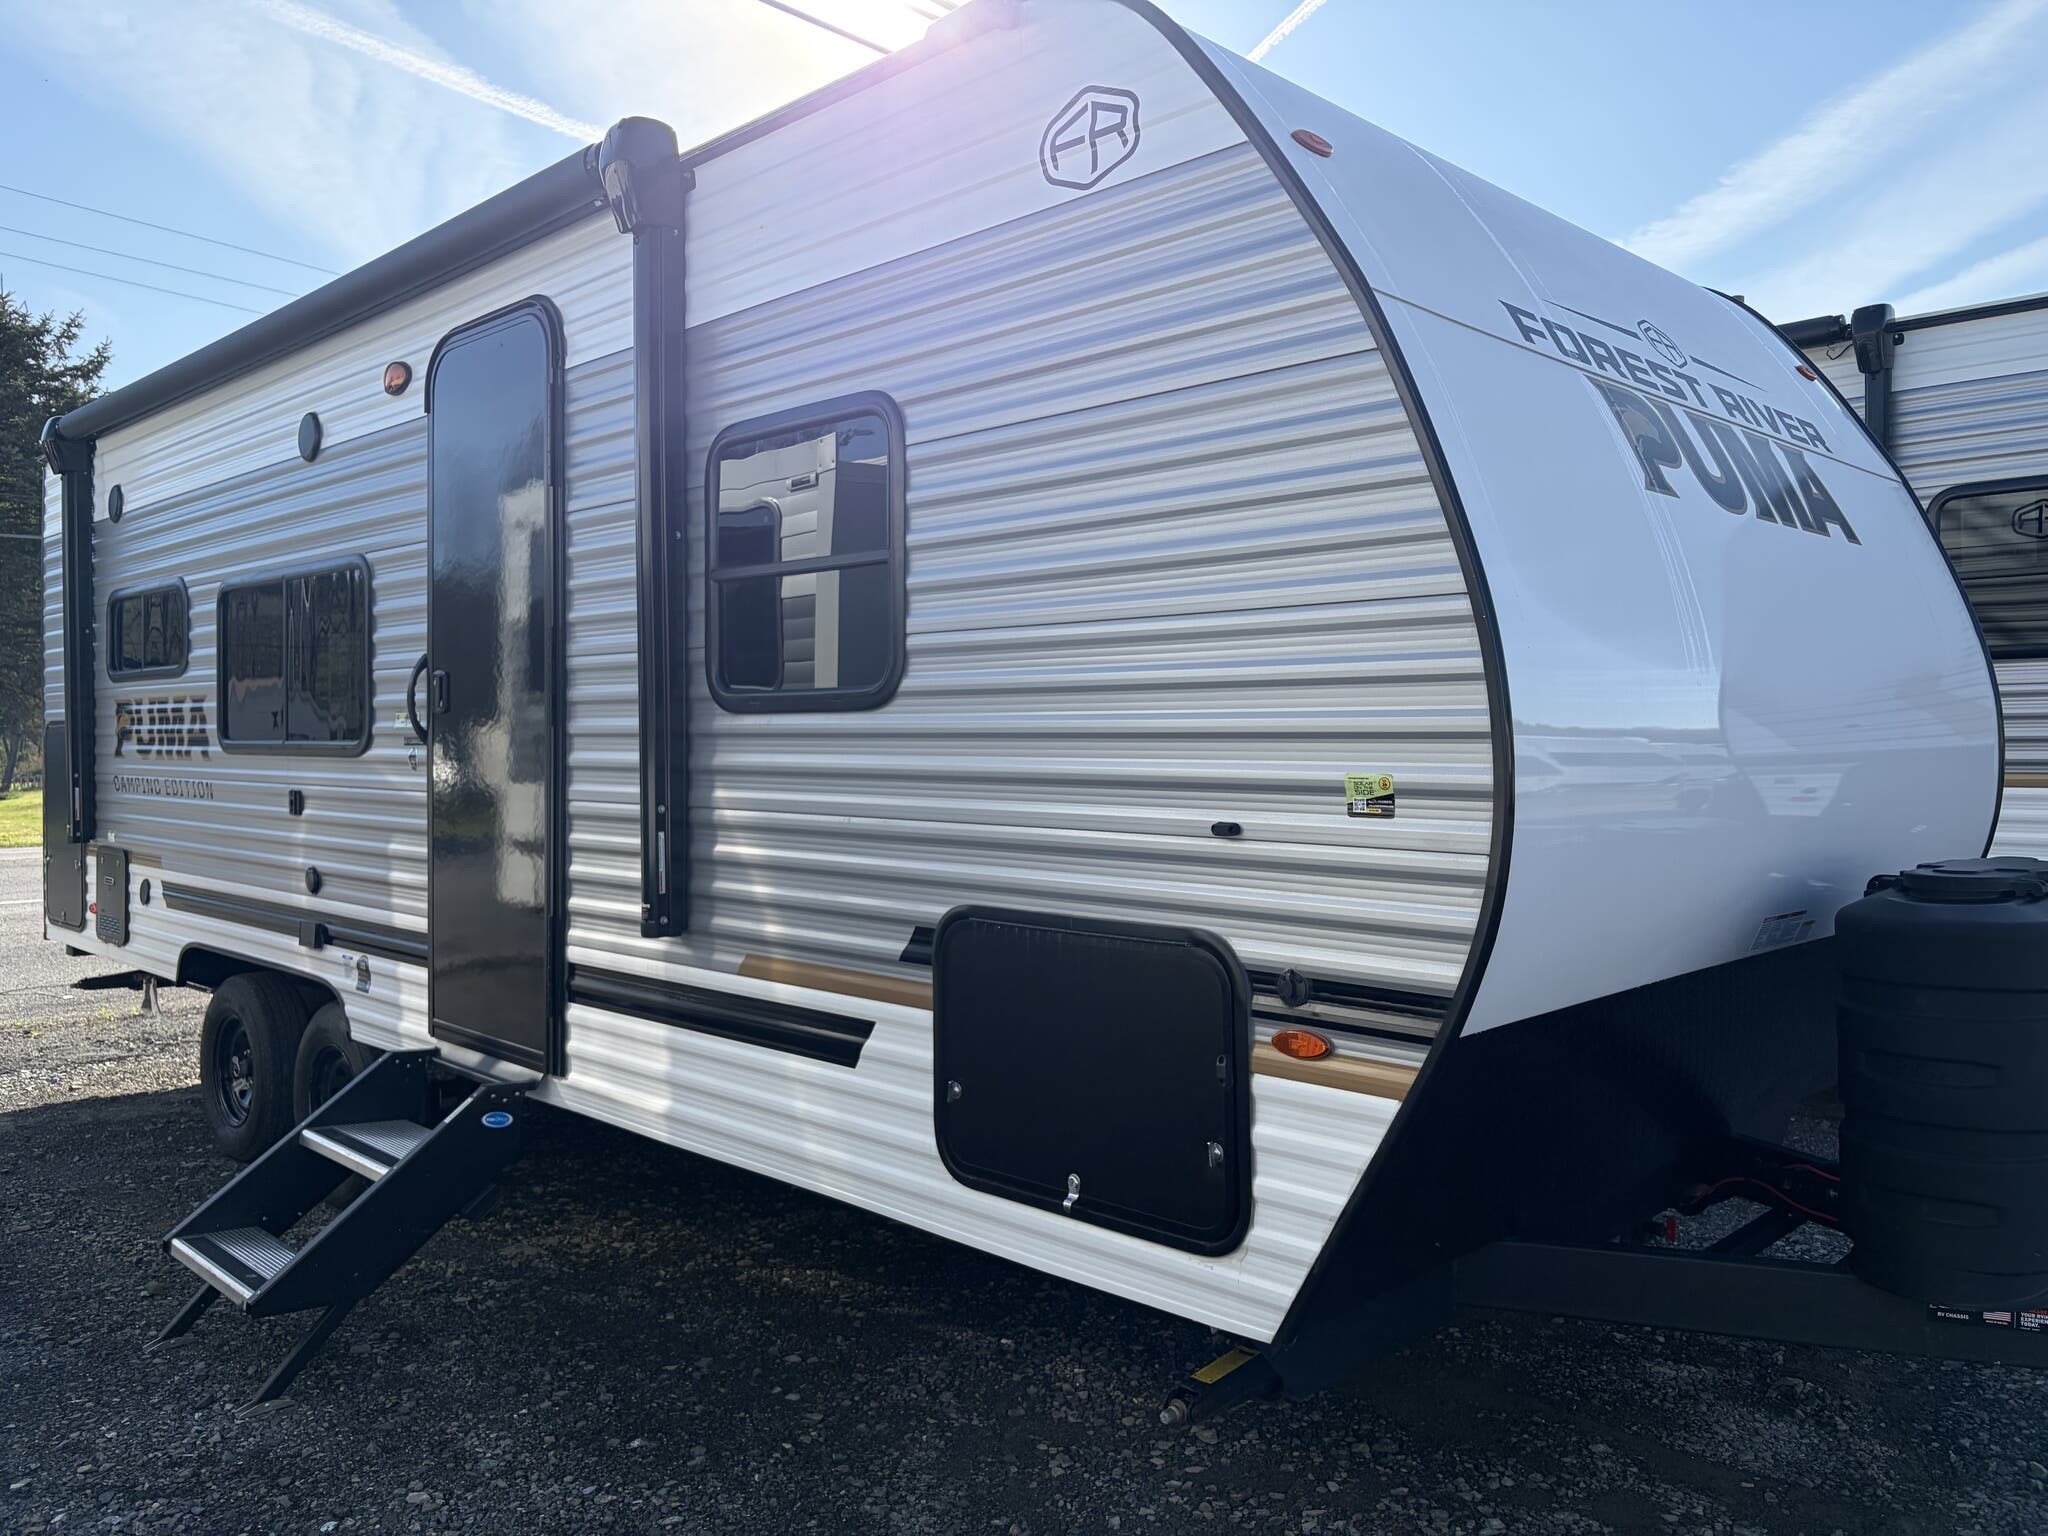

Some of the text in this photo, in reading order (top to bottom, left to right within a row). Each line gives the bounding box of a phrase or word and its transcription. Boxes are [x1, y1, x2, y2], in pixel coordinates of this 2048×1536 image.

[1498, 299, 1833, 454] FOREST RIVER
[1584, 374, 1863, 546] PUMA
[114, 695, 212, 761] PUMA
[113, 775, 214, 800] CAMPING EDITION
[1945, 1312, 1970, 1320] CHASSIS
